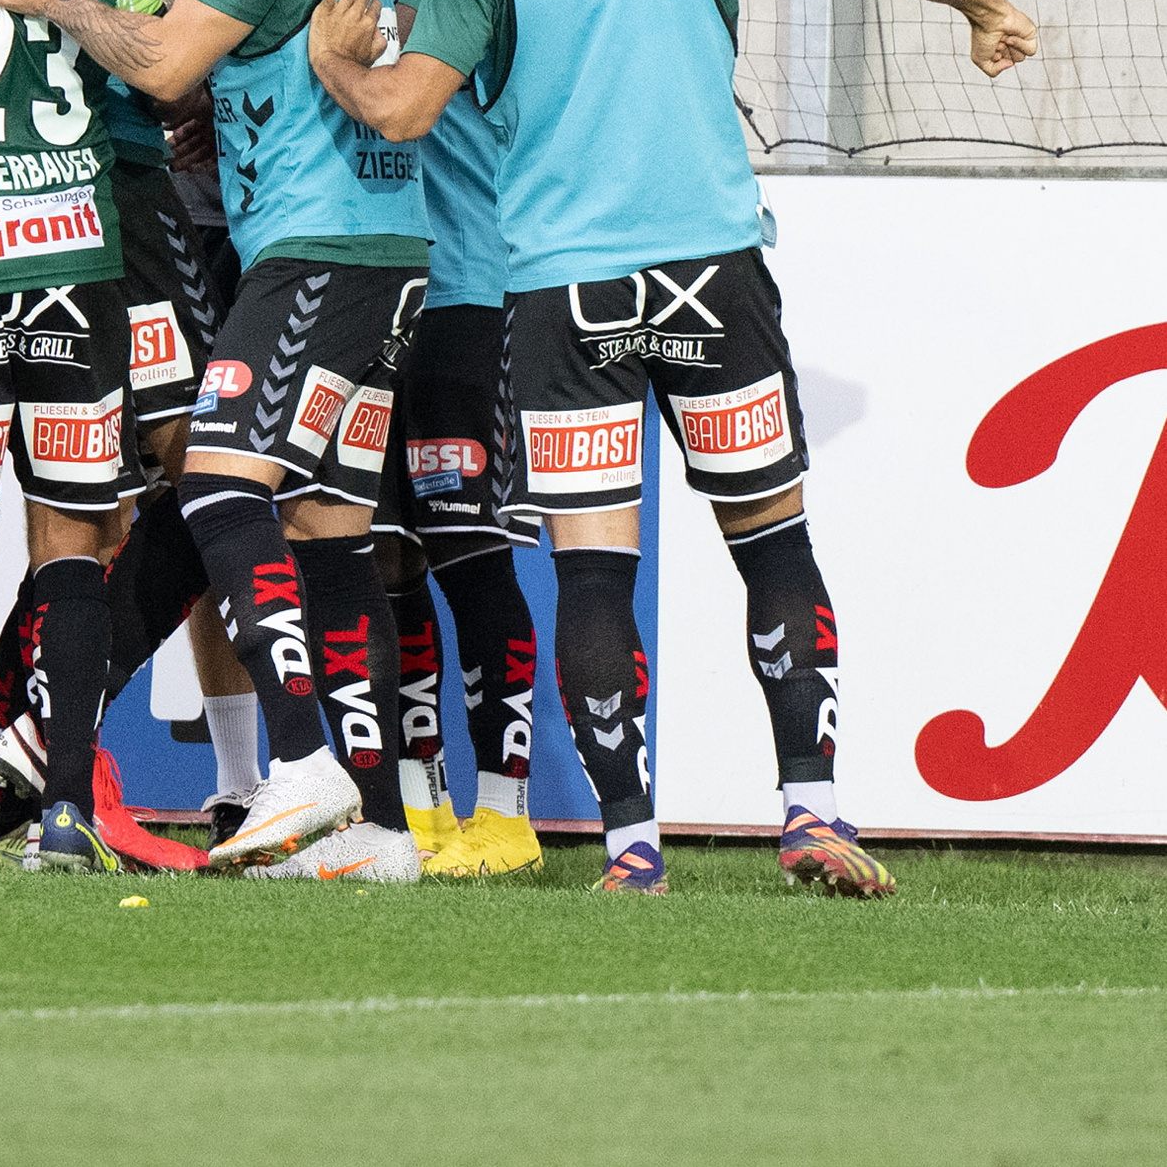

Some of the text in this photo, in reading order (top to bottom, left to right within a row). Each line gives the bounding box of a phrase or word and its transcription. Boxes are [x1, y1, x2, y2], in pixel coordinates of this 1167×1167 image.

[30, 339, 74, 360] GRILL
[649, 336, 661, 352] &
[662, 340, 705, 361] GRILL
[132, 367, 177, 384] Polling
[33, 404, 78, 416] FLIESEN
[81, 404, 89, 415] &
[725, 395, 732, 404] &
[565, 413, 573, 422] &
[577, 410, 609, 422] STEIN
[684, 393, 782, 453] BAUBAST
[531, 423, 638, 469] BAUBAST
[437, 500, 481, 514] hummel
[323, 614, 383, 759] DAXL
[399, 621, 439, 746] DAXL
